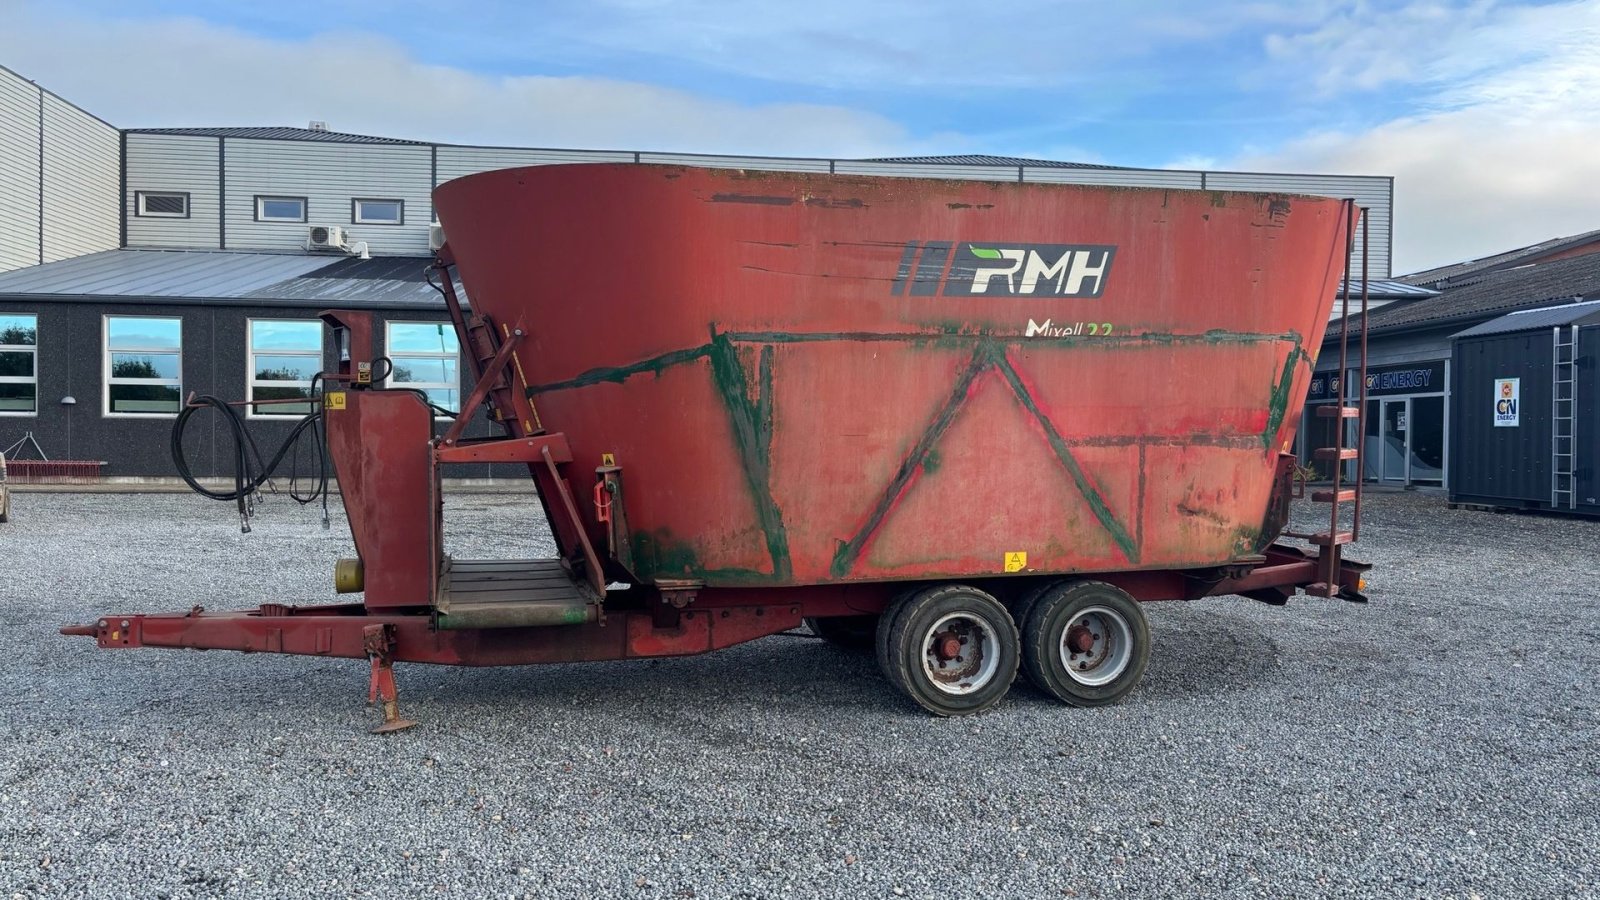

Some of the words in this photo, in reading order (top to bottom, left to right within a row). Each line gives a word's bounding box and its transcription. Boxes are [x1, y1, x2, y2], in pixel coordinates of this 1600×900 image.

[970, 247, 1109, 295] RMH
[1381, 369, 1432, 389] ENERGY
[1497, 399, 1516, 414] CN
